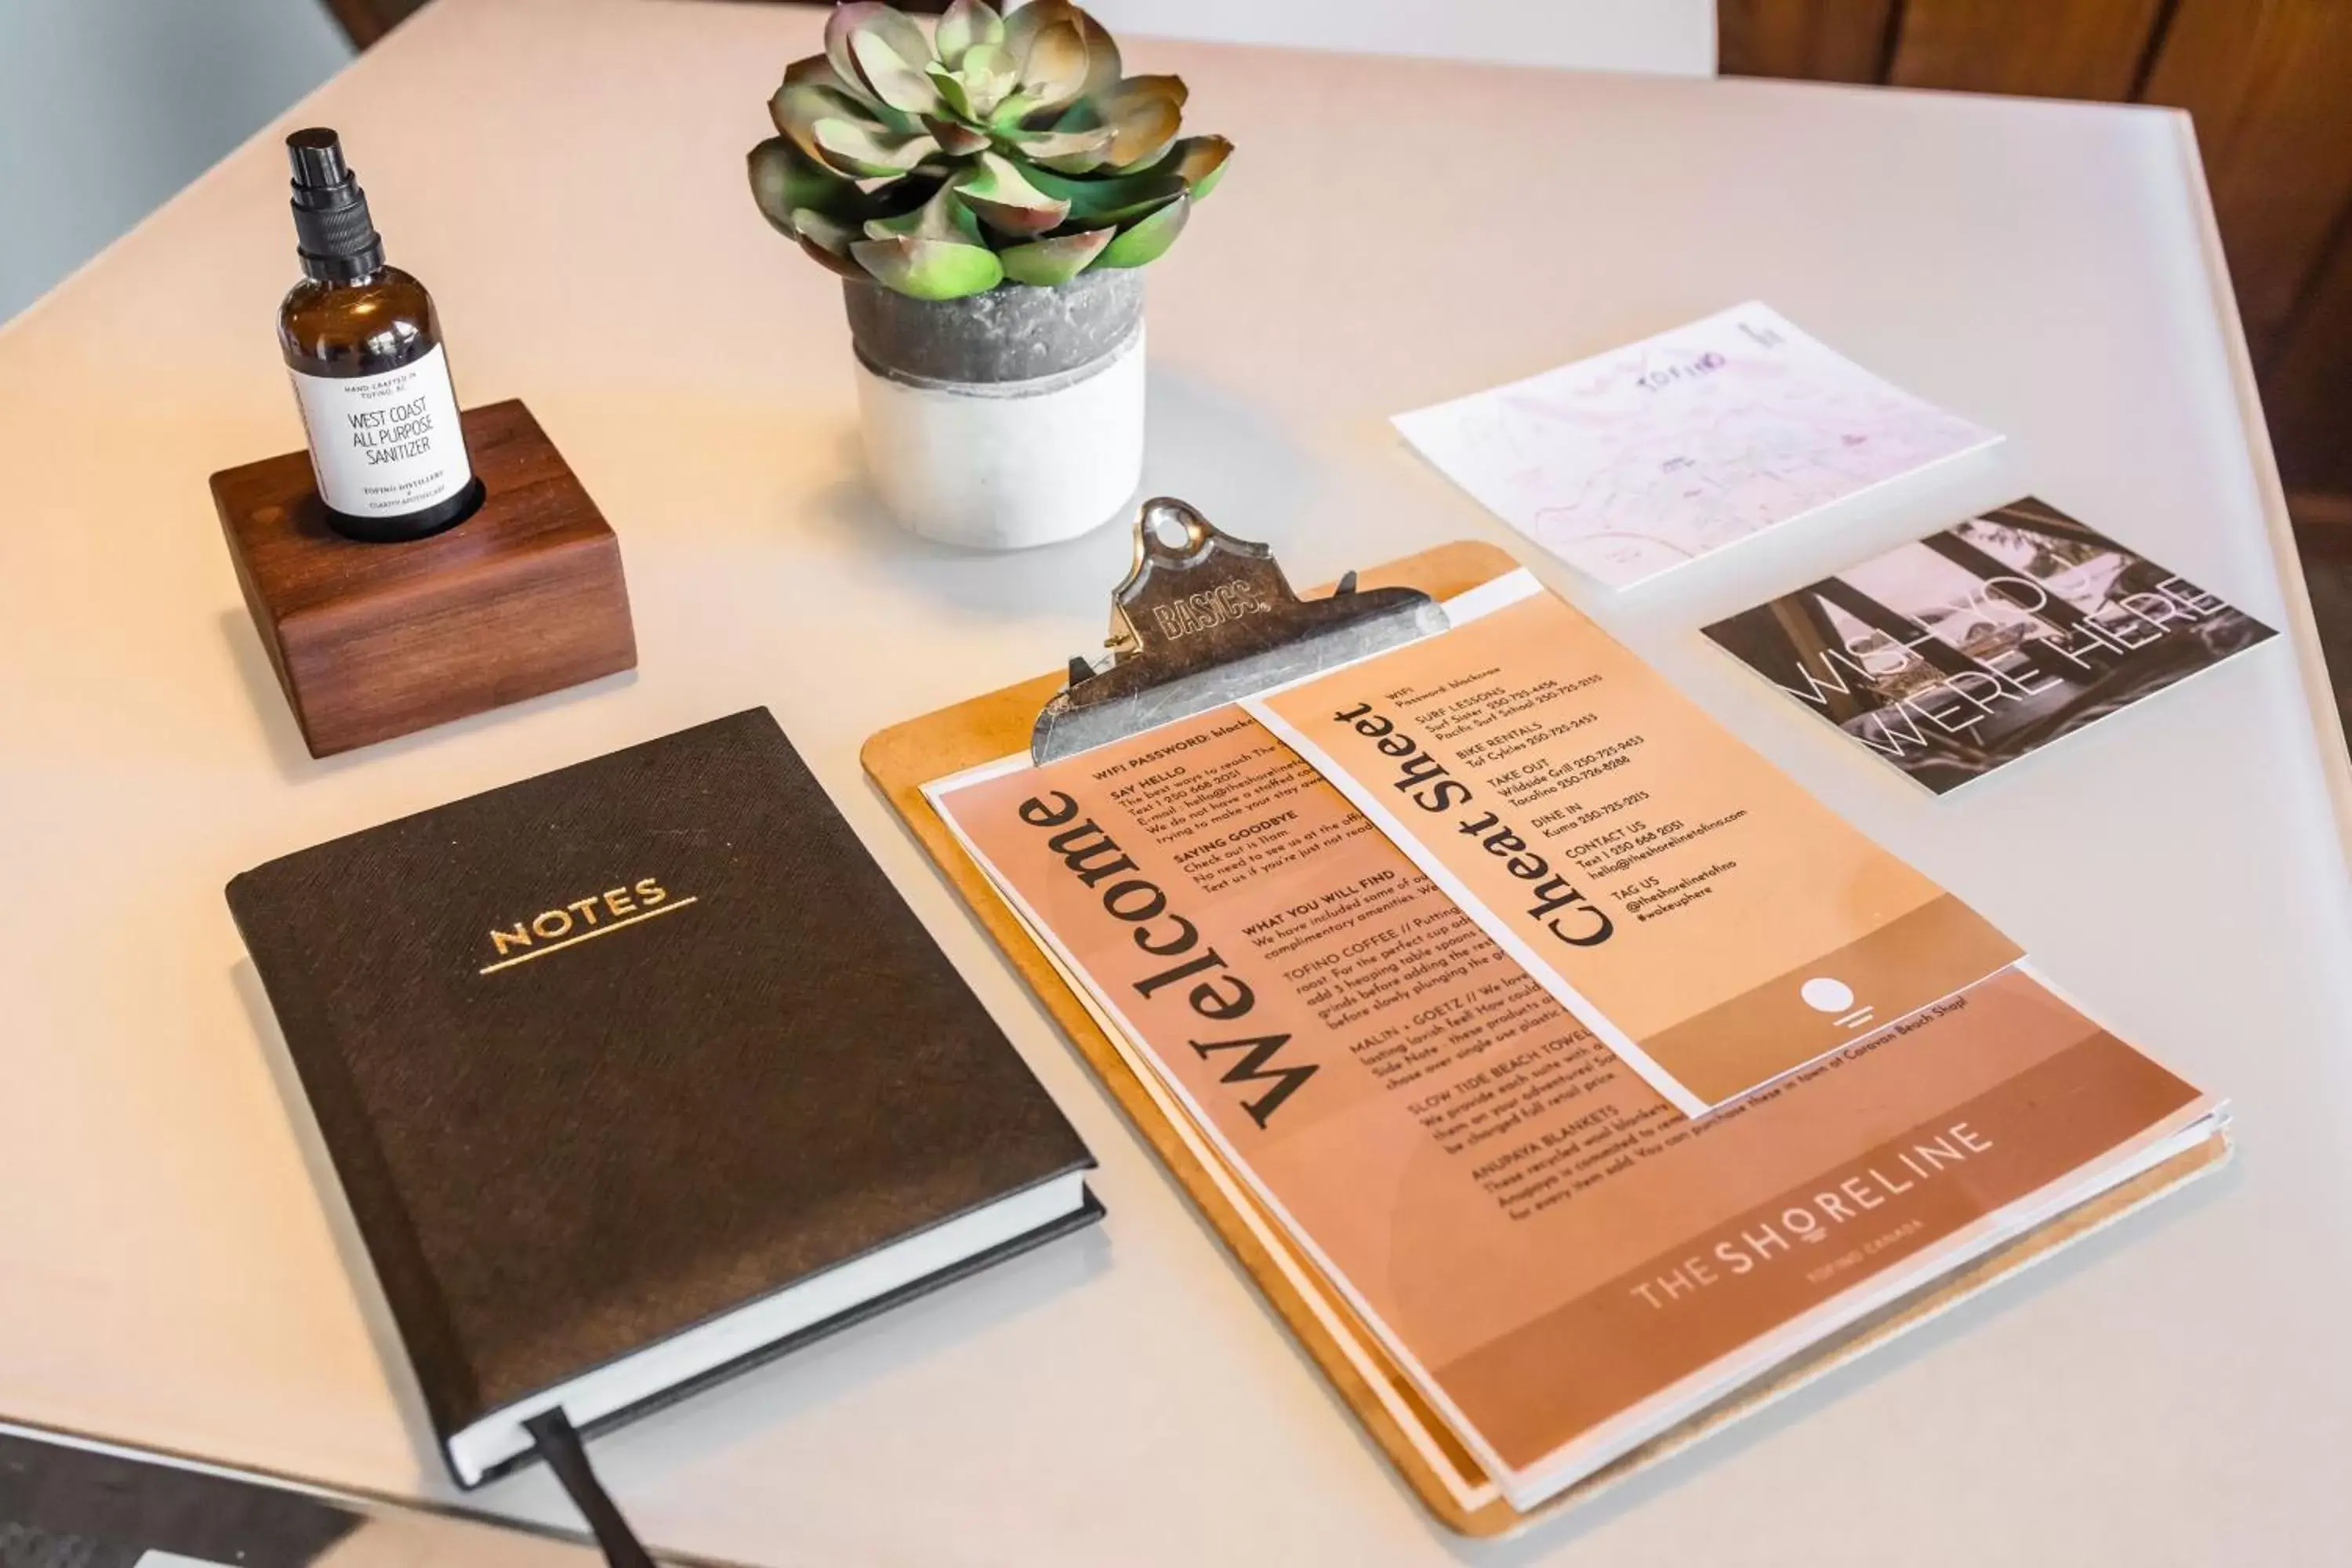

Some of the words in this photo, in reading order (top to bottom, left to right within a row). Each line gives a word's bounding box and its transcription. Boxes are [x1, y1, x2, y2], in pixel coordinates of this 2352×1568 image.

[347, 410, 386, 430] WEST
[390, 395, 426, 423] COAST
[354, 431, 378, 448] ALL
[379, 413, 434, 444] PURPOSE
[366, 436, 430, 465] SANITIZER
[1776, 615, 1959, 704] WISH
[1859, 650, 2064, 757] WERE
[2039, 577, 2233, 669] HERE
[1414, 708, 1445, 723] SURF
[1448, 687, 1504, 711] LESSONS
[1425, 718, 1449, 732] Surf
[1450, 709, 1482, 723] Sister
[1435, 725, 1472, 740] Pacific
[1473, 713, 1497, 726] Surf
[1498, 699, 1534, 717] School
[1334, 702, 1474, 813] Sheet
[1455, 742, 1484, 759] BIKE
[1486, 722, 1541, 746] RENTALS
[1465, 756, 1485, 768] Tof
[1092, 764, 1127, 779] WIFI
[1110, 785, 1134, 800] SAY
[1138, 766, 1185, 788] HELLO
[1118, 797, 1142, 807] The
[1143, 785, 1170, 798] best
[1173, 774, 1202, 787] ways
[1220, 753, 1251, 770] reach
[1251, 746, 1276, 757] The
[1486, 769, 1520, 786] TAKE
[1522, 758, 1548, 773] OUT
[1497, 775, 1547, 797] Wildside
[1548, 763, 1573, 777] Grill
[1508, 786, 1557, 806] Tacofino
[1127, 804, 1153, 815] Text
[1163, 790, 1187, 803] 250
[1145, 823, 1167, 833] We
[1170, 817, 1185, 826] do
[1189, 807, 1207, 818] not
[1208, 797, 1239, 809] have
[1254, 772, 1294, 793] staffed
[1156, 827, 1193, 844] trying
[1210, 808, 1242, 822] make
[1244, 797, 1269, 810] your
[1273, 786, 1298, 798] stay
[1530, 810, 1565, 828] DINE
[1565, 802, 1582, 814] IN
[1174, 838, 1226, 862] SAYING
[1229, 811, 1297, 840] GOODBYE
[1192, 873, 1214, 883] No
[1217, 857, 1247, 873] need
[1265, 844, 1285, 855] see
[1288, 838, 1301, 847] us
[1304, 830, 1317, 840] at
[1319, 823, 1339, 833] the
[1542, 822, 1577, 837] Kuma
[1566, 829, 1624, 858] CONTACT
[1625, 821, 1646, 833] US
[1575, 855, 1602, 868] Text
[1610, 841, 1634, 855] 250
[1635, 832, 1657, 845] 668
[1656, 820, 1683, 835] 2051
[1183, 854, 1222, 872] Check
[1224, 846, 1243, 858] out
[1202, 880, 1229, 892] Text
[1232, 874, 1247, 883] us
[1247, 866, 1257, 875] if
[1261, 854, 1296, 872] you're
[1298, 843, 1320, 858] just
[1323, 834, 1342, 846] not
[1458, 811, 1615, 946] Cheat
[1242, 914, 1283, 935] WHAT
[1286, 900, 1319, 916] YOU
[1320, 886, 1359, 903] WILL
[1359, 870, 1394, 888] FIND
[1610, 884, 1639, 900] TAG
[1639, 876, 1659, 887] US
[1626, 862, 1736, 912] @theshorelinetofino
[1637, 887, 1711, 921] #wakeuphere
[489, 877, 666, 955] NOTES
[1251, 935, 1274, 946] We
[1275, 923, 1306, 938] have
[1310, 898, 1360, 924] included
[1363, 887, 1394, 902] some
[1396, 879, 1409, 889] of
[1018, 790, 1321, 1130] Welcome
[1265, 919, 1353, 959] complimentary
[1283, 953, 1339, 980] TOFINO
[1342, 929, 1398, 956] COFFEE
[1413, 906, 1461, 927] Putting
[1330, 965, 1352, 978] For
[1356, 956, 1377, 967] the
[1381, 935, 1423, 959] perfect
[1426, 926, 1448, 938] cup
[1307, 989, 1332, 1005] add
[1343, 964, 1399, 988] heaping
[1399, 949, 1431, 964] table
[1435, 931, 1475, 950] spoons
[1318, 996, 1357, 1019] grinds
[1357, 978, 1399, 999] before
[1403, 958, 1448, 980] adding
[1448, 949, 1469, 960] the
[1326, 1008, 1369, 1029] before
[1373, 991, 1410, 1010] slowly
[1412, 967, 1468, 994] plunging
[1468, 957, 1489, 968] the
[1349, 1027, 1399, 1053] MALIN
[1413, 997, 1463, 1025] GOETZ
[1478, 984, 1500, 994] We
[1359, 1044, 1407, 1065] lasting
[1406, 1025, 1444, 1044] lavish
[1475, 1000, 1504, 1014] How
[1508, 980, 1541, 1001] could
[1371, 1062, 1402, 1076] Side
[1404, 1047, 1437, 1063] Note
[1448, 1026, 1483, 1044] these
[1486, 1003, 1539, 1029] products
[1896, 1015, 1933, 1034] Beach
[1407, 1090, 1450, 1114] SLOW
[1454, 1073, 1490, 1092] TIDE
[1490, 1051, 1540, 1077] BEACH
[1541, 1105, 1617, 1146] BLANKETS
[1629, 1256, 1720, 1309] THE
[1714, 1121, 1994, 1274] SHORELINE
